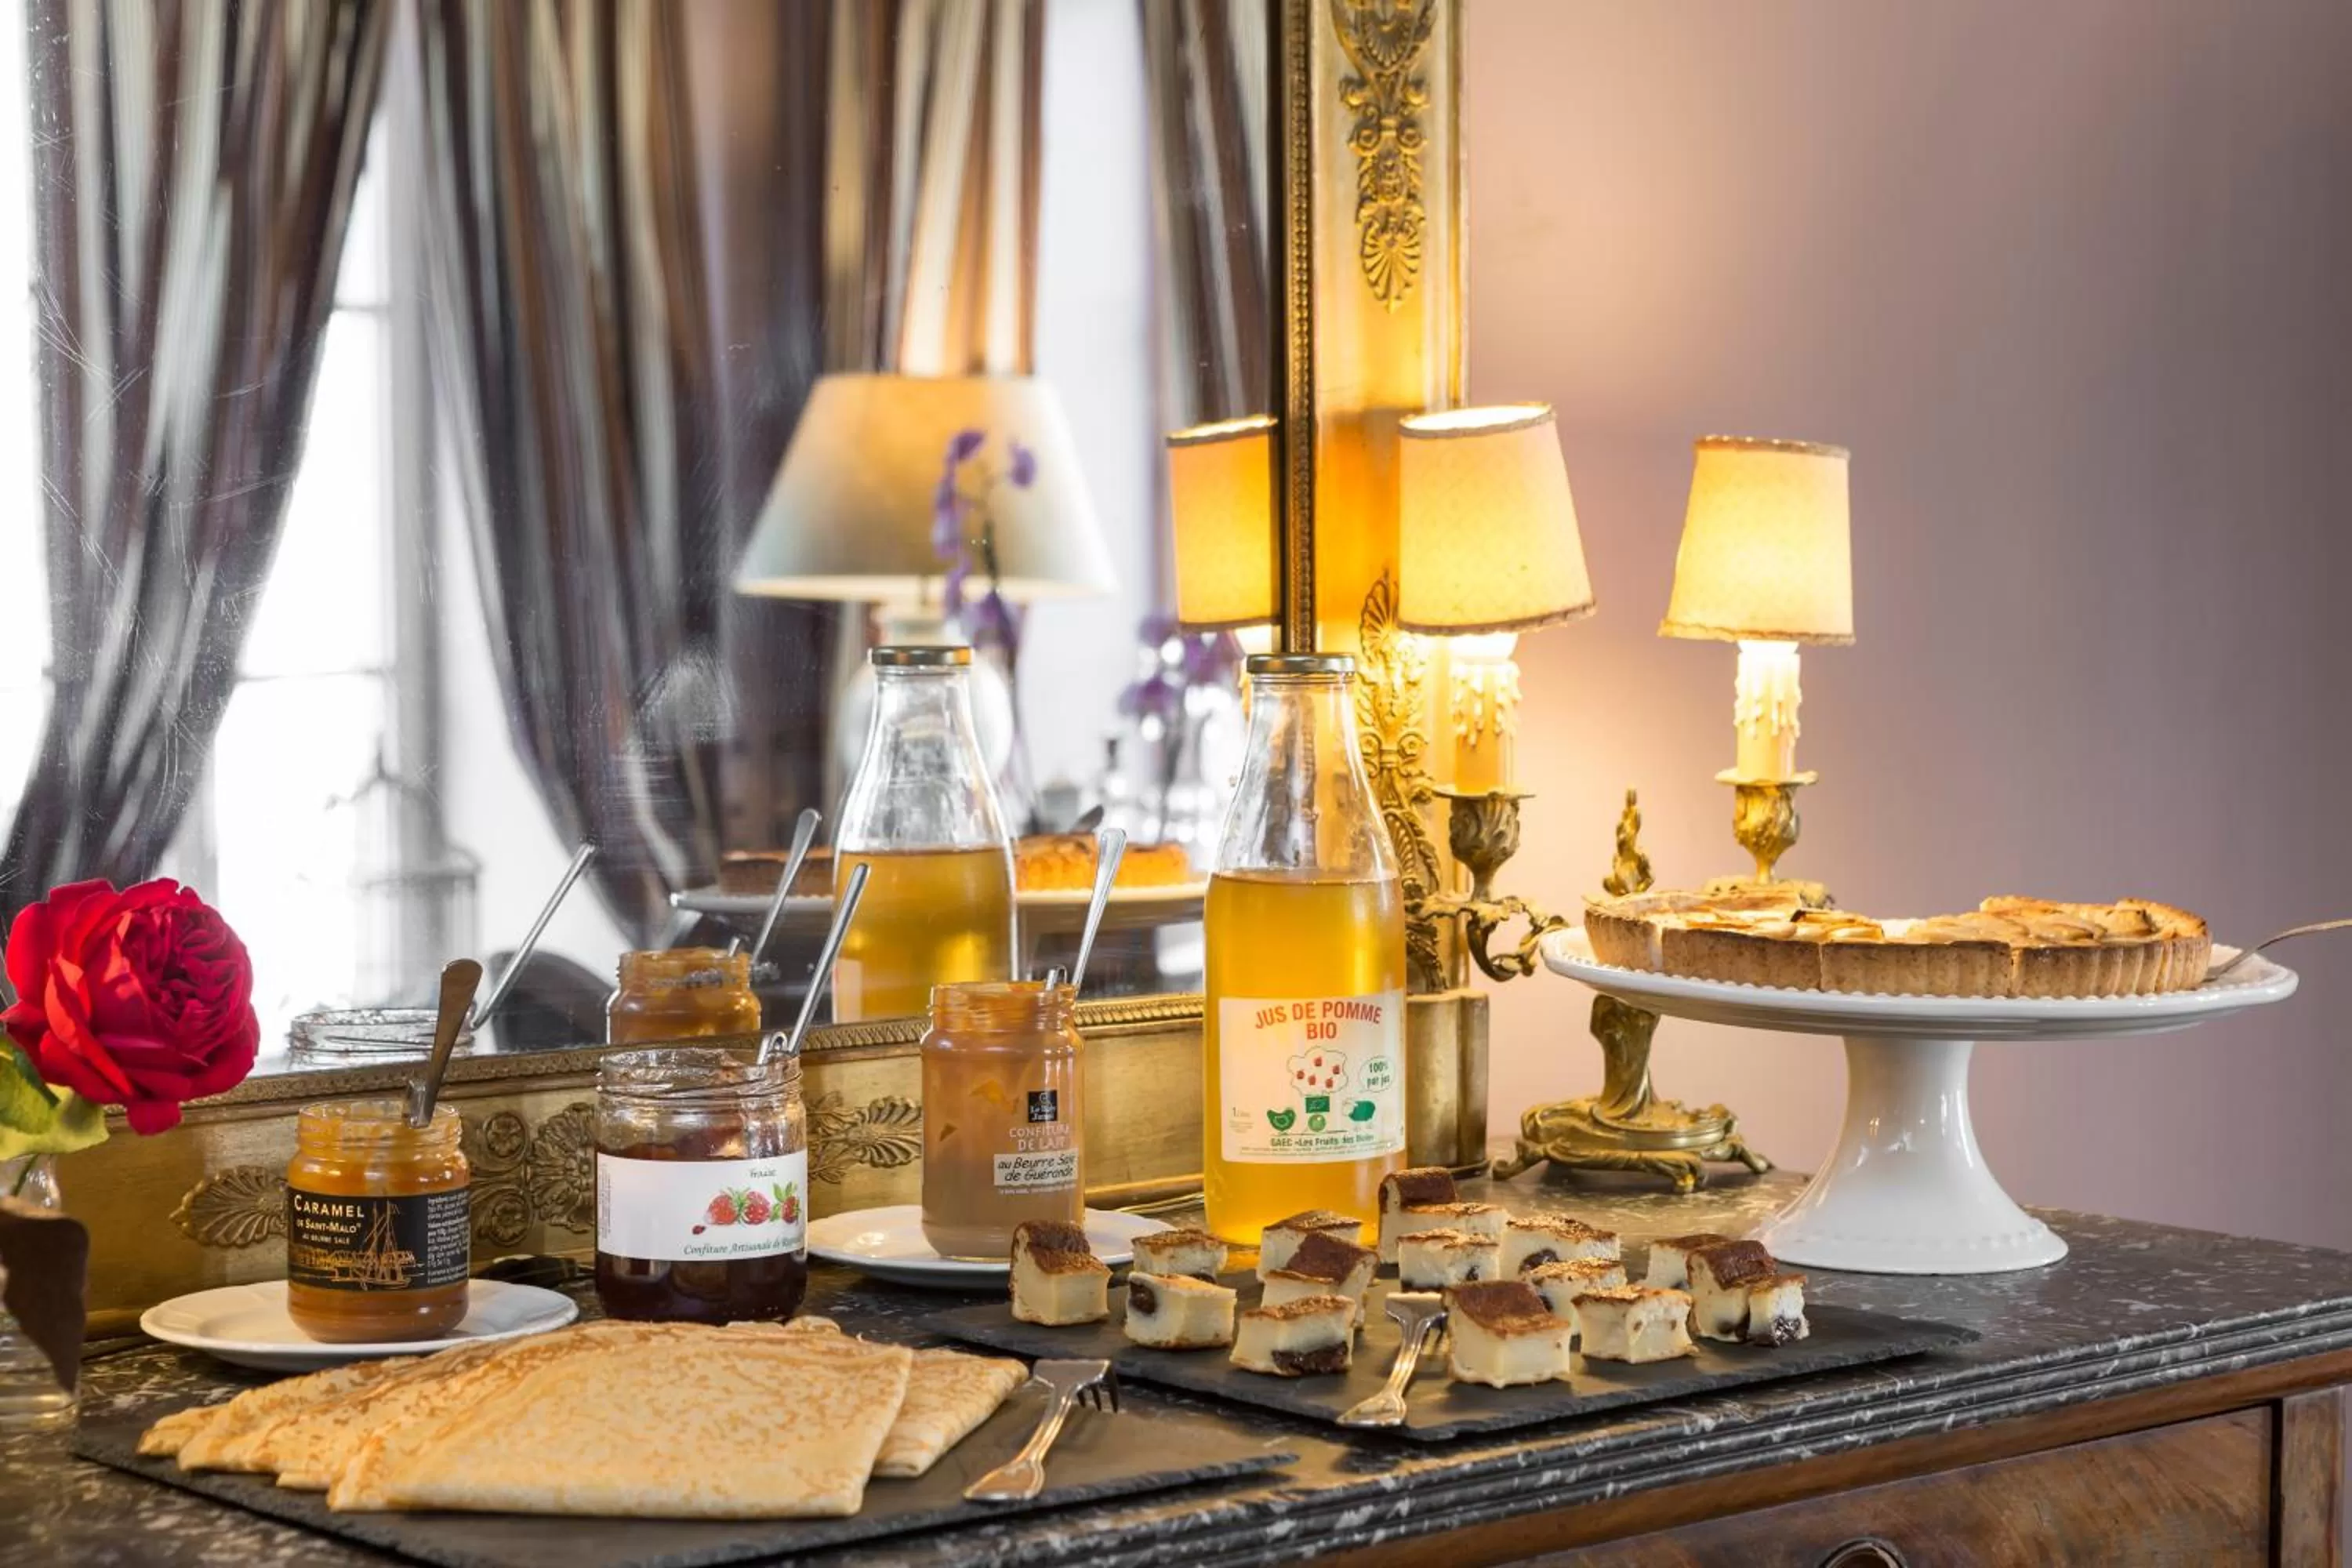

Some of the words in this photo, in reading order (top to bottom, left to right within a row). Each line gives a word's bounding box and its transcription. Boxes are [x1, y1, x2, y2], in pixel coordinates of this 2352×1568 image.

[1254, 1006, 1287, 1029] JUS
[1292, 1003, 1316, 1020] DE
[1322, 1001, 1383, 1024] POMME
[1306, 1022, 1337, 1040] BIO
[1018, 1138, 1034, 1151] DE
[1039, 1136, 1065, 1149] LAIT
[997, 1160, 1011, 1169] au
[1013, 1156, 1054, 1169] Beurre
[1004, 1169, 1021, 1181] de
[1024, 1165, 1073, 1181] Guérande
[294, 1194, 365, 1218] CARAMEL
[684, 1243, 728, 1256] Confiture
